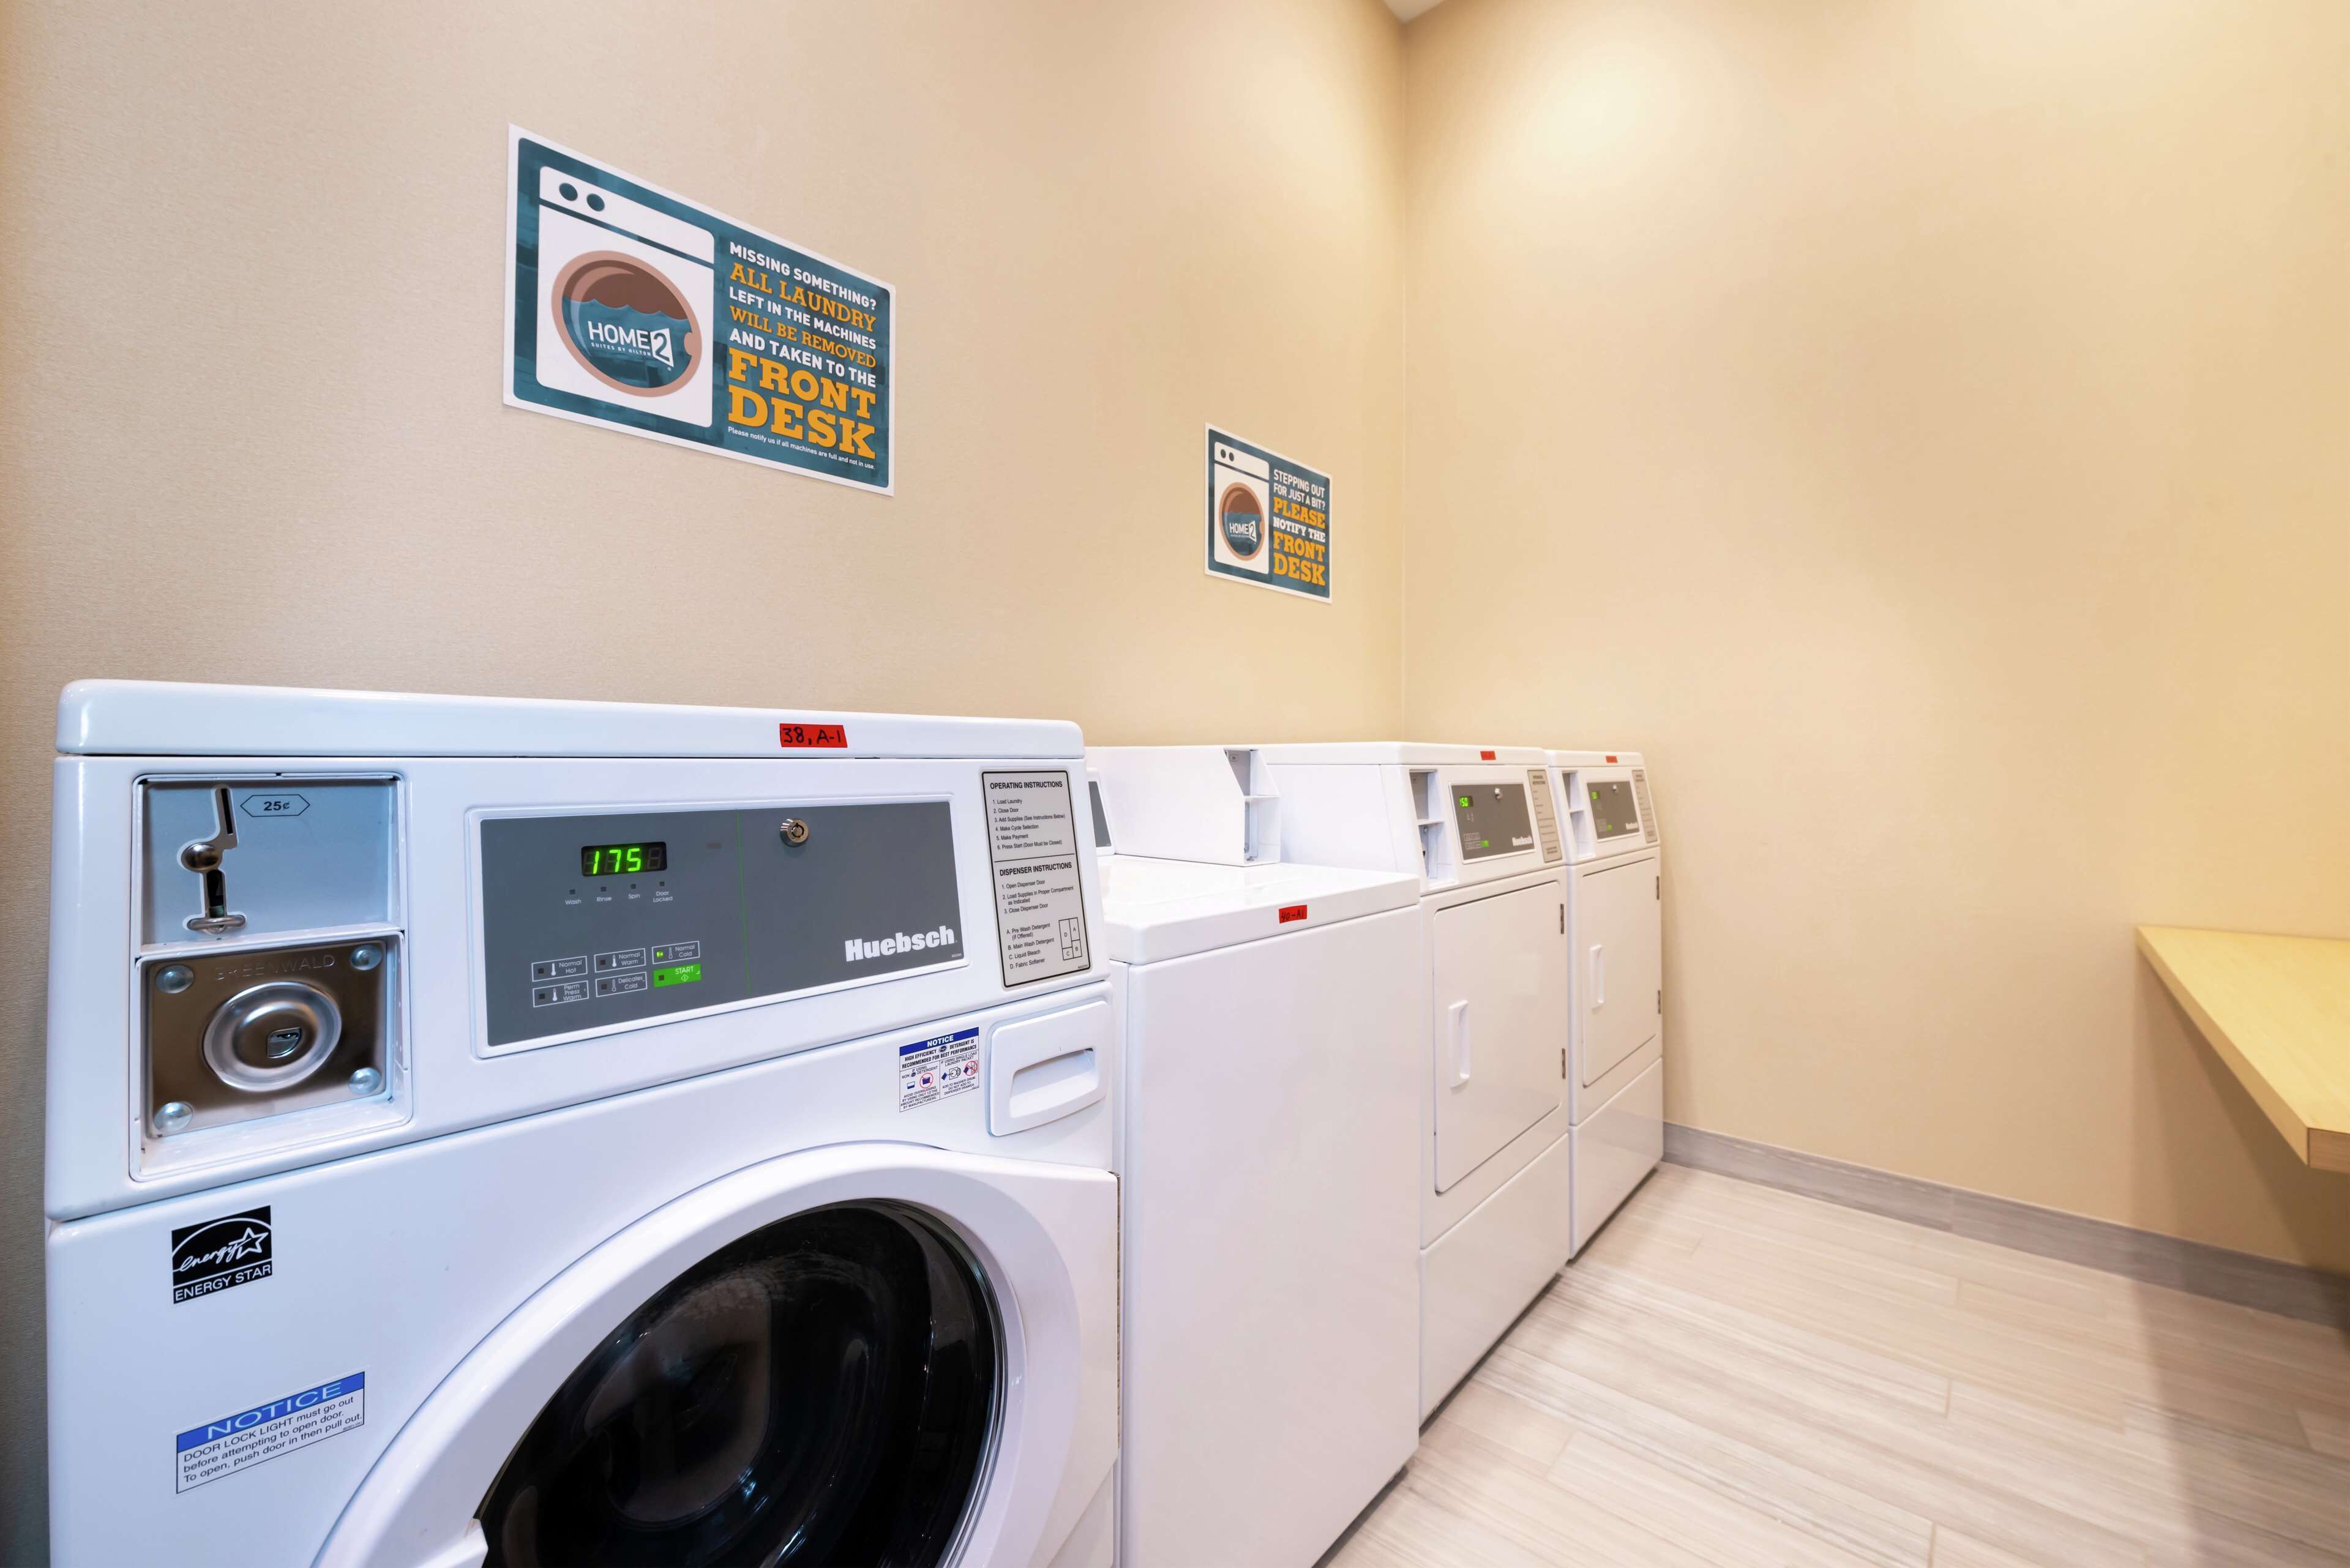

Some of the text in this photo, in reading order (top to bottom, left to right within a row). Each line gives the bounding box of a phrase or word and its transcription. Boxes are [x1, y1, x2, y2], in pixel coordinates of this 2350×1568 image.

[730, 241, 877, 310] MISSING SOMETHING?
[730, 263, 876, 332] ALL LAUNDRY
[730, 286, 877, 349] LEFT IN THE MACHINES
[730, 305, 877, 368] WILL BE REMOVED
[729, 328, 876, 388] AND TAKEN TO THE
[728, 347, 876, 419] FRONT
[728, 384, 875, 459] DESK
[728, 426, 749, 437] Please
[750, 433, 767, 443] notify
[790, 443, 817, 455] machines
[1273, 469, 1325, 499] STEPPING OUT
[1273, 483, 1325, 510] FOR JUST A BIT?
[1273, 496, 1325, 529] PLEASE
[1273, 516, 1325, 543] NOTIFY THE
[1273, 531, 1325, 562] FRONT
[1273, 552, 1325, 586] DESK
[264, 801, 290, 811] 25¢
[593, 848, 642, 875] 175
[1000, 862, 1072, 876] DISPENSER INSTRUCTIONS
[845, 925, 954, 962] Huebsch
[559, 960, 582, 968] Normal
[618, 975, 643, 984] Delicates
[675, 966, 694, 974] START
[902, 1056, 931, 1069] RECOMMENDED
[951, 1044, 976, 1055] PERFORMANCE
[915, 1049, 937, 1059] EFFICIENCY
[949, 1040, 970, 1050] DETERGENT
[927, 1035, 954, 1048] NOTICE
[179, 1243, 239, 1272] energy
[175, 1264, 271, 1301] ENERGY STAR
[208, 1381, 342, 1440] NOTICE
[184, 1397, 353, 1462] DOOR LOCK LIGHT must go out
[184, 1456, 218, 1473] before
[222, 1435, 276, 1459] attempting
[293, 1420, 317, 1433] open
[320, 1411, 344, 1424] door.
[200, 1463, 230, 1476] open,
[234, 1451, 260, 1466] push
[263, 1441, 286, 1454] door
[301, 1428, 322, 1440] then
[325, 1420, 342, 1433] pull
[345, 1414, 362, 1424] out.
